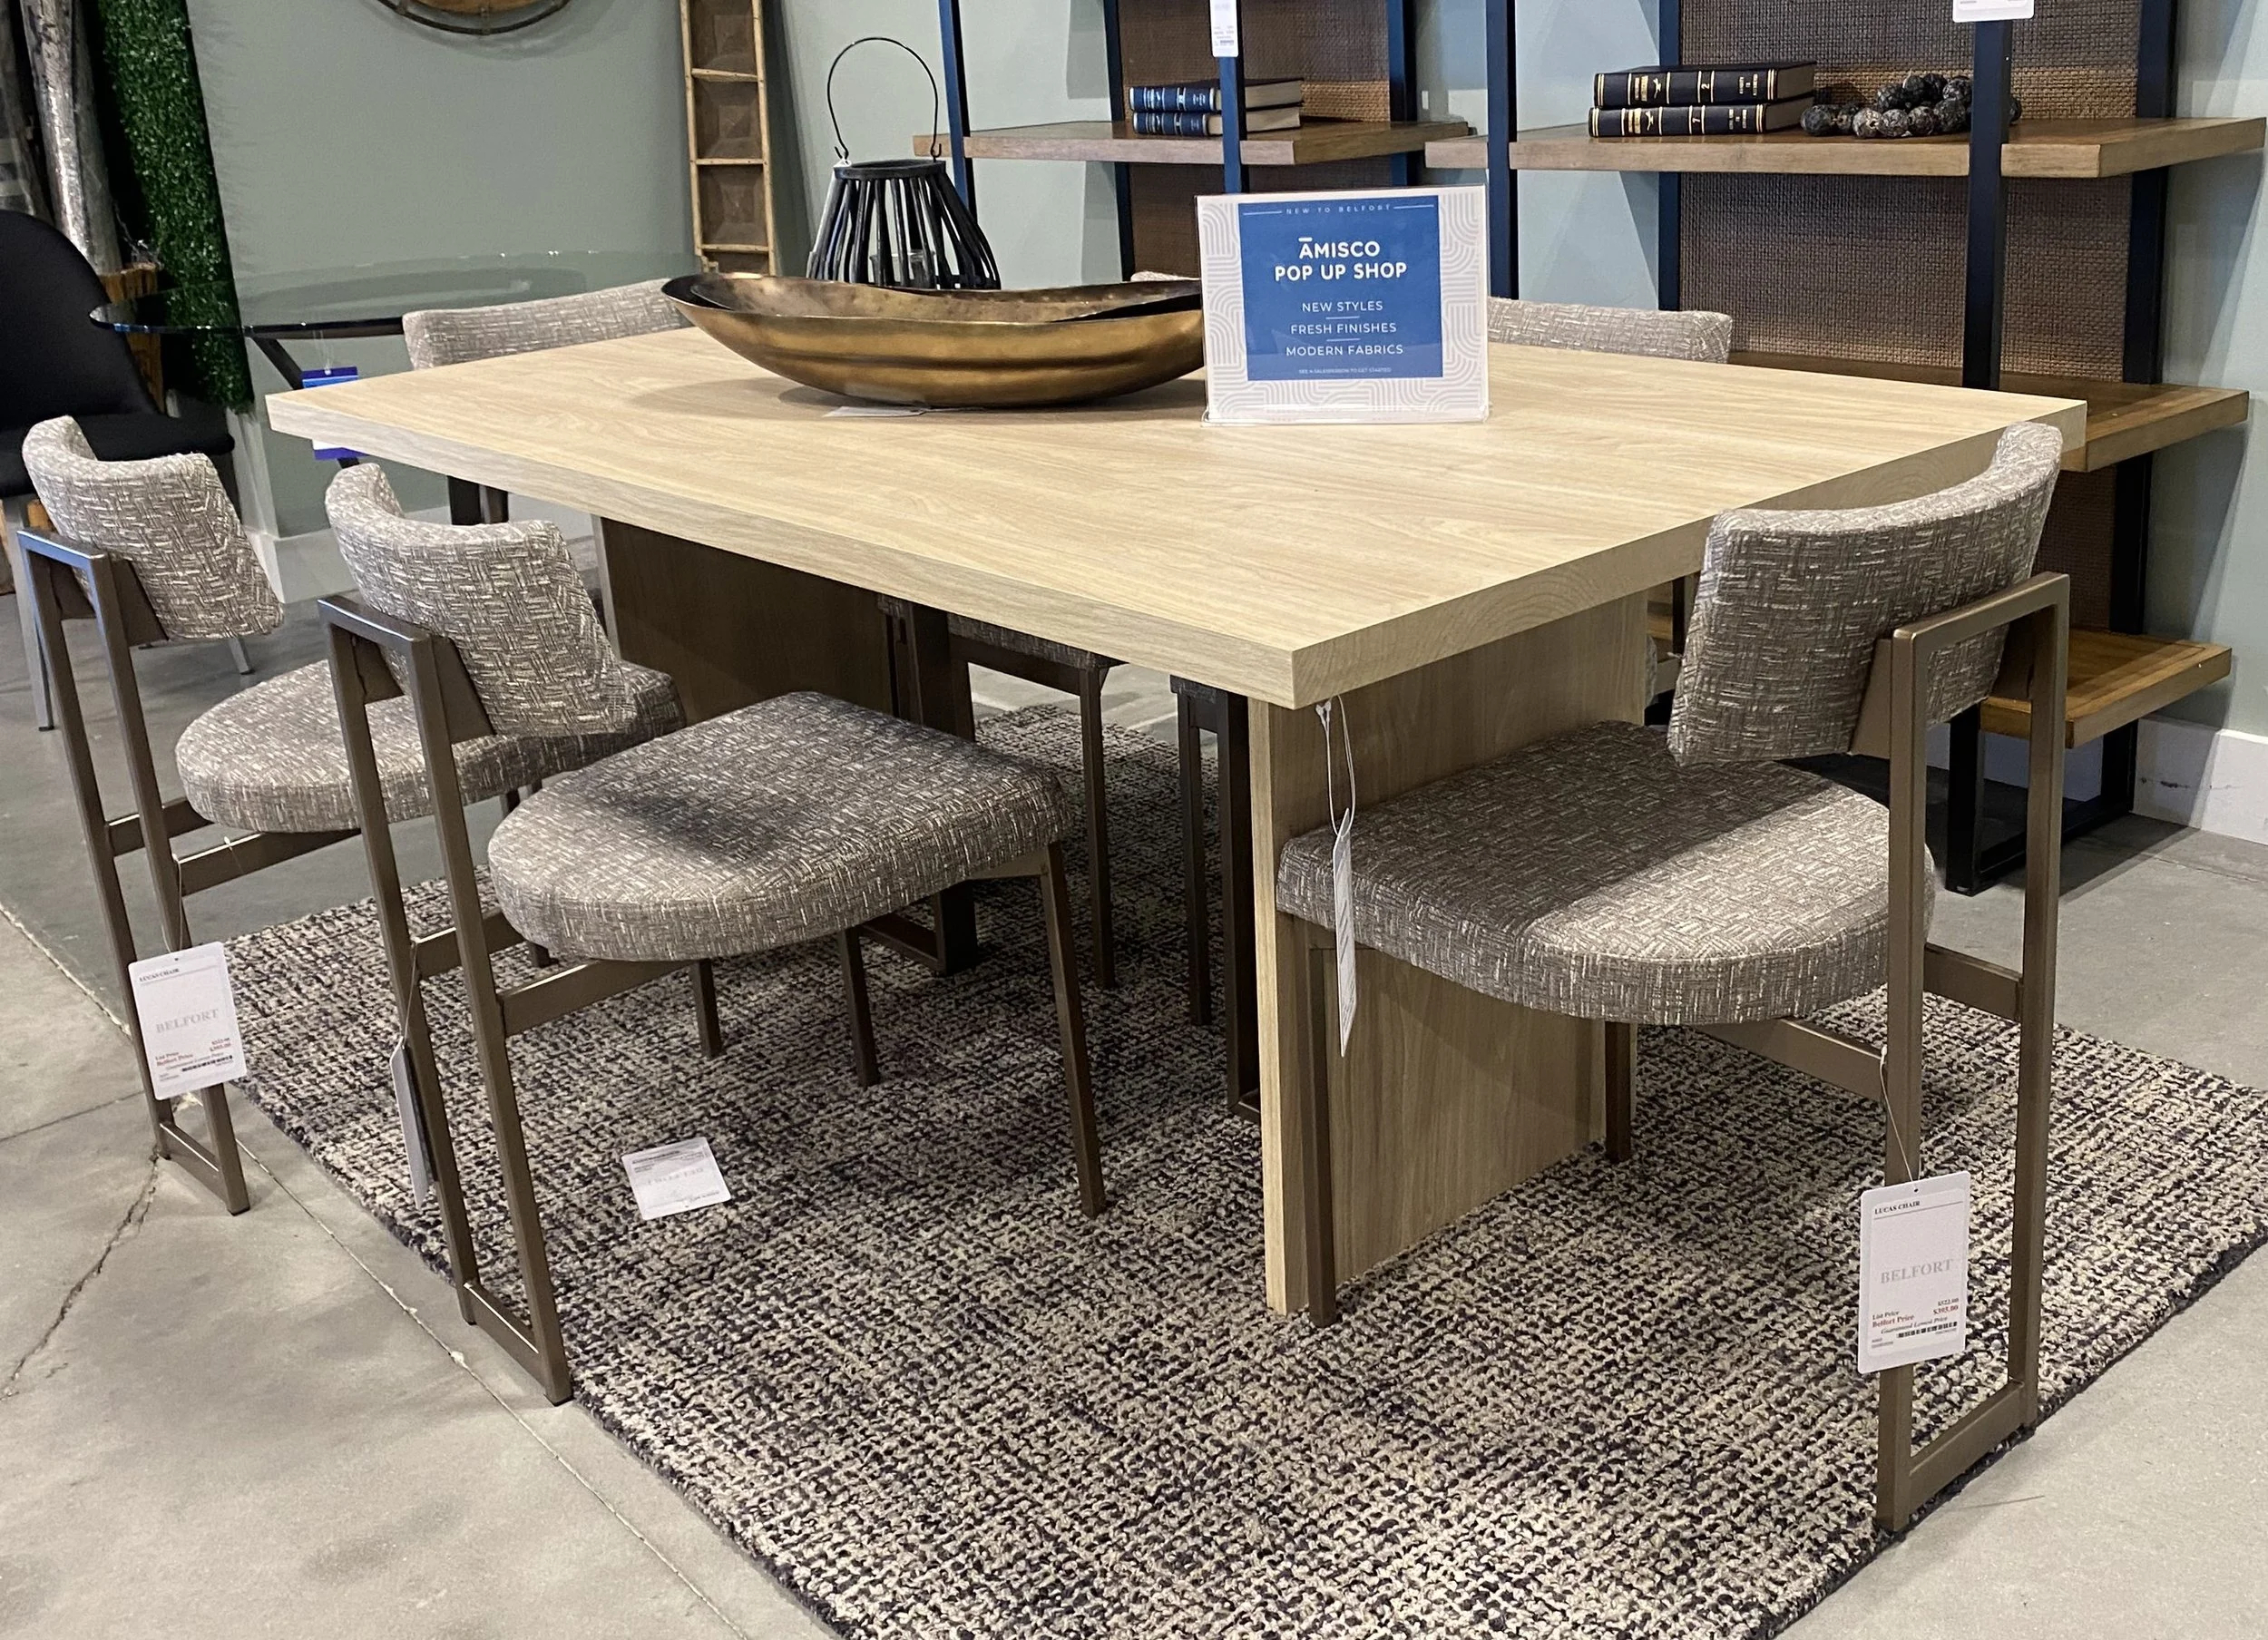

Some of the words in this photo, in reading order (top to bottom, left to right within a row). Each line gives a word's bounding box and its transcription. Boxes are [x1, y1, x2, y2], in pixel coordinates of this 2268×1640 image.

[1339, 204, 1390, 212] BELFORT
[1274, 264, 1313, 281] POP
[1320, 263, 1346, 280] UP
[1354, 261, 1407, 279] SHOP
[1302, 301, 1332, 312] NEW
[1336, 300, 1383, 312] STYLES
[1291, 324, 1332, 335] FRESH
[1336, 322, 1397, 334] FINISHES
[1286, 346, 1343, 356] MODERN
[1348, 344, 1403, 355] FABRICS
[155, 1009, 219, 1033] BELFORT
[1874, 1205, 1897, 1215] LUCAS
[1898, 1200, 1921, 1210] CHAIR
[1881, 1259, 1953, 1284] BELFORT
[1872, 1319, 1895, 1328] Belfort
[1897, 1314, 1914, 1323] Price
